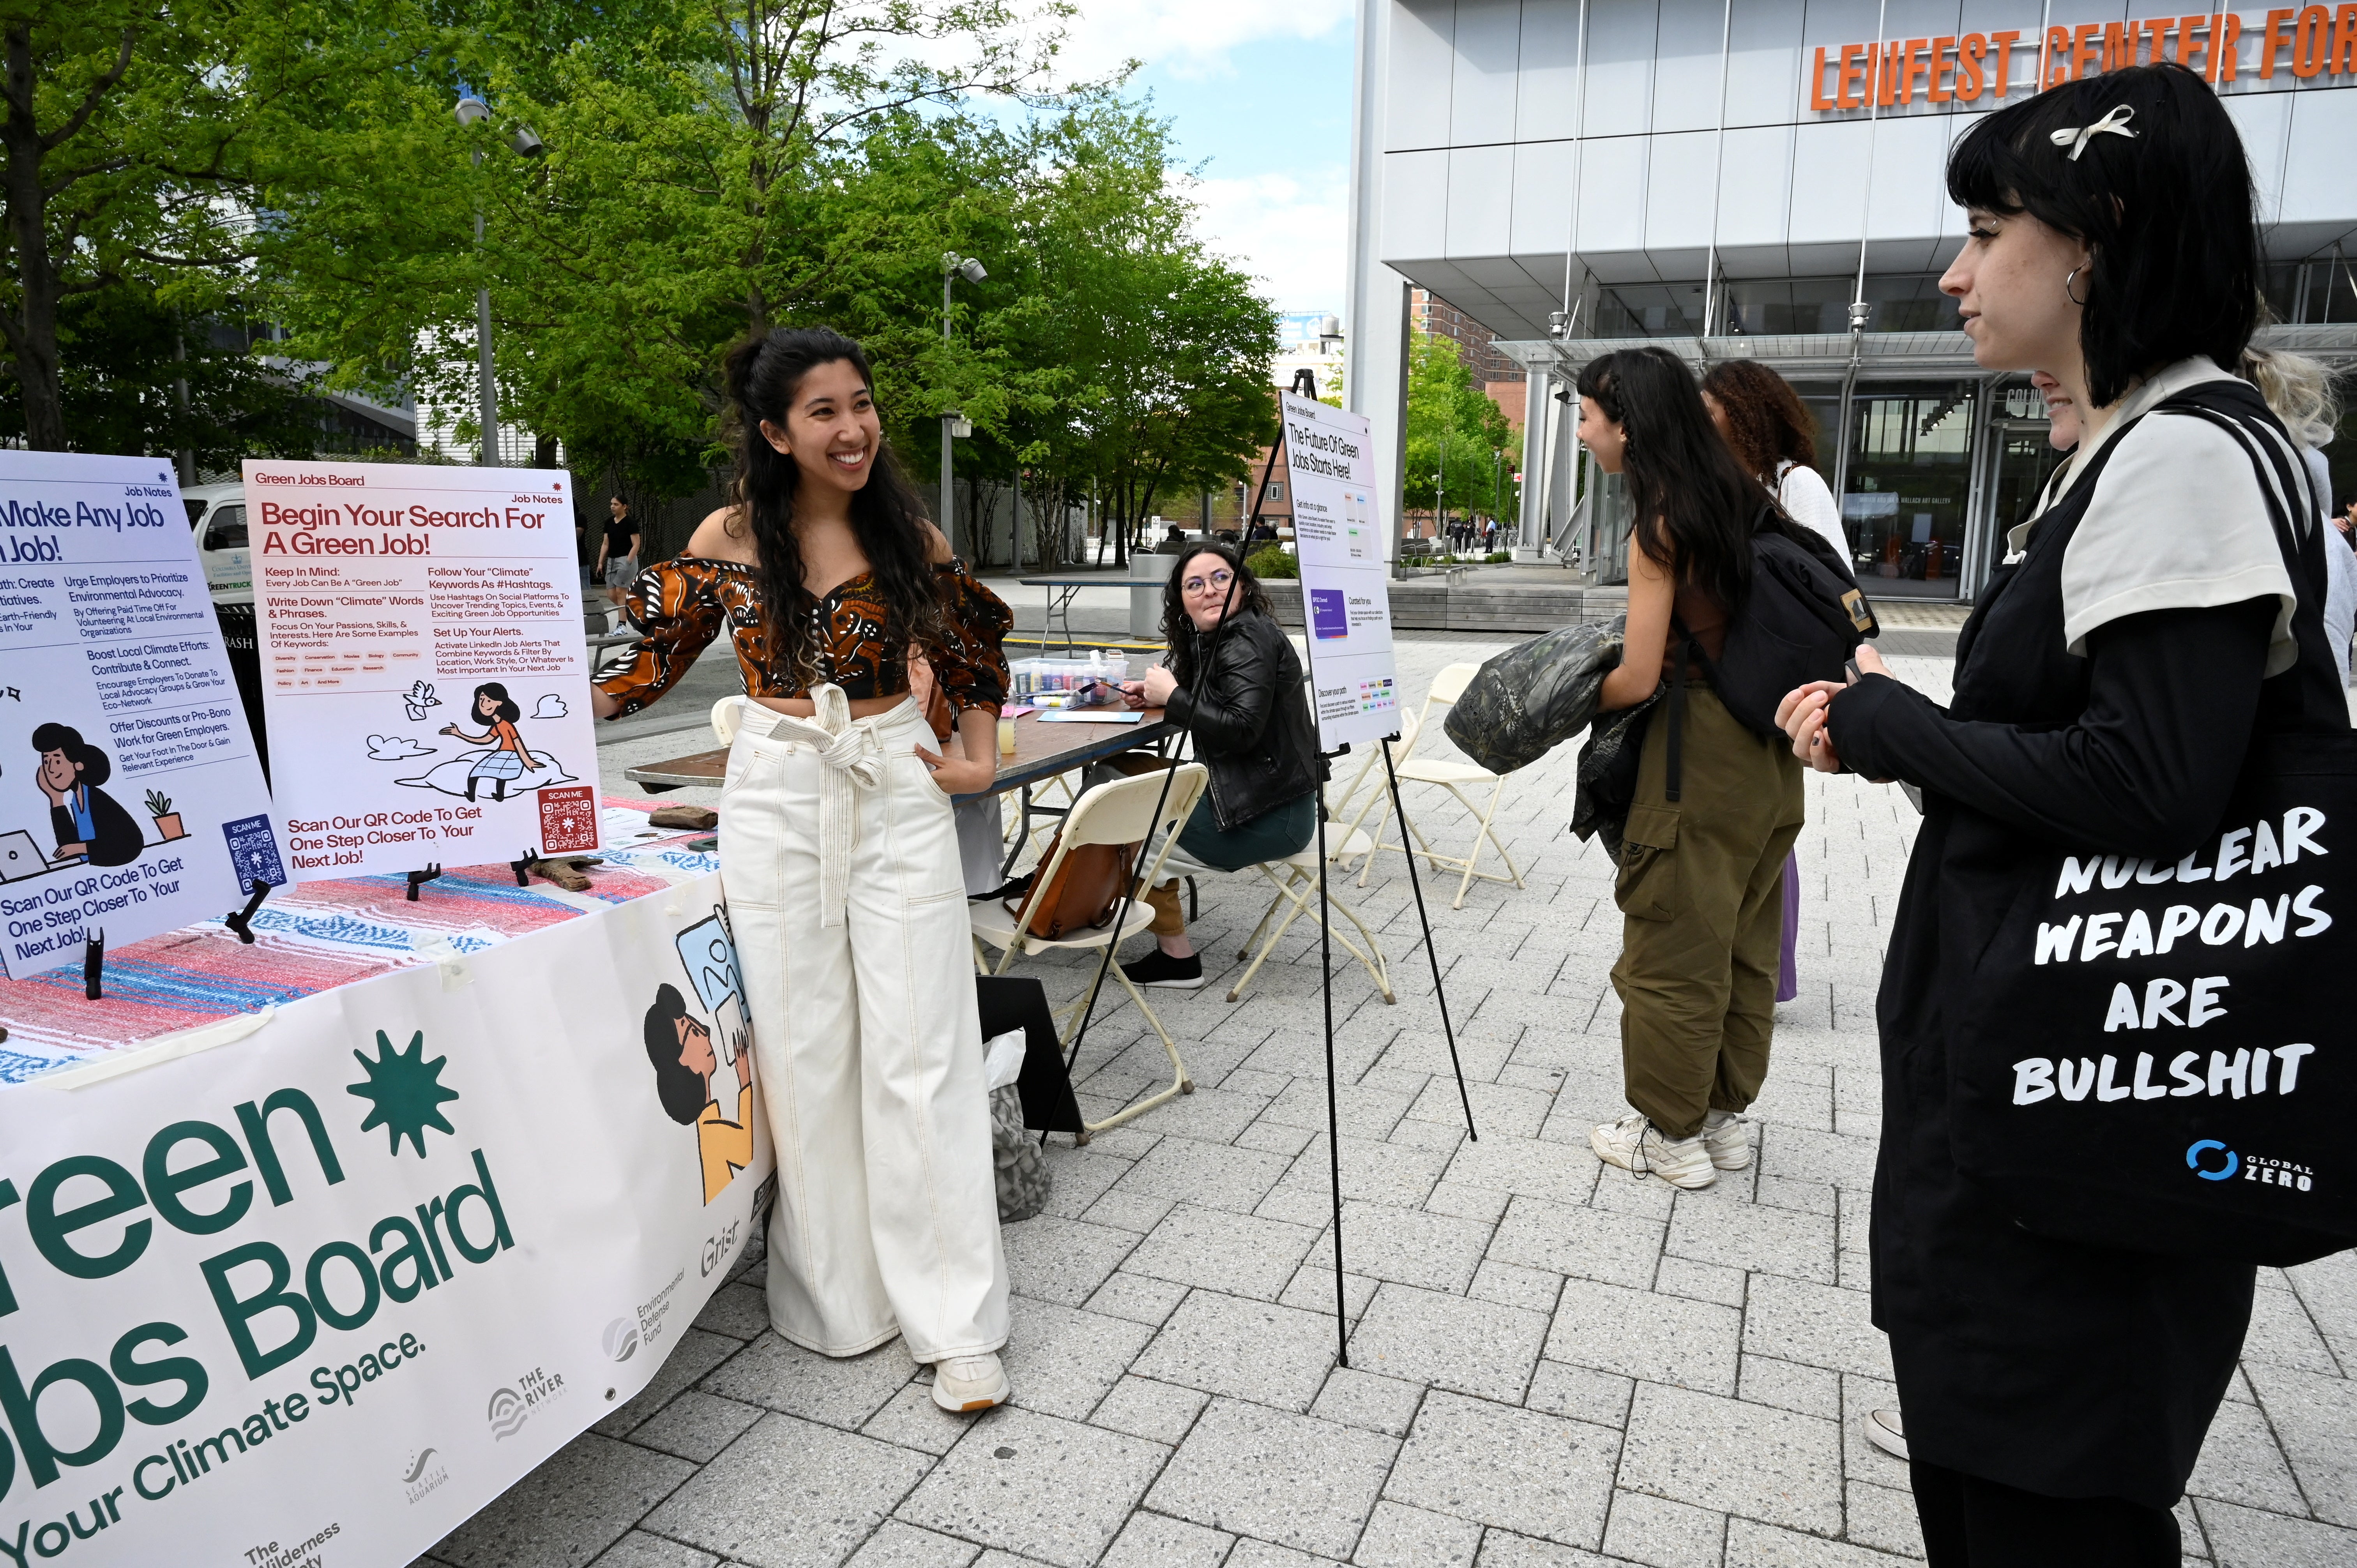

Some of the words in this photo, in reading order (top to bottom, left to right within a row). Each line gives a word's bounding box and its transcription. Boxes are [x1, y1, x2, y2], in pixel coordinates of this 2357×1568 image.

[1811, 31, 2020, 111] LENFEST
[2037, 13, 2241, 92] CENTER
[2260, 3, 2357, 79] FOR
[1286, 401, 1297, 414] Green
[1297, 405, 1306, 417] Jobs
[1305, 408, 1316, 420] Board
[1288, 422, 1304, 445] The
[1304, 427, 1328, 452] Future
[1329, 434, 1338, 454] Of
[1338, 437, 1359, 459] Green
[1292, 448, 1309, 471] Jobs
[1309, 452, 1332, 476] Starts
[1332, 458, 1351, 480] Here!
[125, 486, 143, 496] Job
[143, 486, 172, 497] Notes
[255, 472, 296, 484] Green
[298, 473, 327, 486] Jobs
[328, 474, 365, 486] Board
[511, 494, 531, 503] Job
[532, 494, 563, 504] Notes
[0, 500, 72, 527] Make
[76, 501, 121, 533] Any
[125, 502, 164, 527] Job
[261, 502, 341, 531] Begin
[343, 503, 405, 526] Your
[409, 505, 500, 528] Search
[505, 507, 545, 529] For
[10, 535, 63, 562] Job!
[263, 531, 288, 554] A
[291, 531, 375, 555] Green
[378, 533, 430, 555] Job!
[64, 576, 89, 589] Urge
[89, 575, 140, 588] Employers
[139, 575, 150, 584] to
[150, 572, 189, 583] Prioritize
[265, 567, 294, 578] Keep
[296, 567, 307, 576] In
[309, 567, 340, 576] Mind:
[431, 610, 463, 619] Exciting
[506, 609, 560, 618] Opportunities
[1348, 597, 1360, 605] Curated
[80, 626, 132, 639] Organizations
[433, 628, 452, 637] Set
[453, 628, 468, 639] Up
[468, 627, 491, 636] Your
[493, 627, 524, 636] Alerts.
[87, 649, 117, 660] Boost
[116, 645, 143, 658] Local
[143, 644, 179, 655] Climate
[178, 641, 210, 652] Efforts:
[102, 697, 152, 710] Eco-Network
[1318, 689, 1332, 697] Discover
[110, 721, 134, 733] Offer
[135, 715, 181, 729] Discounts
[182, 714, 191, 722] or
[191, 708, 231, 721] Pro-Bono
[548, 791, 571, 800] SCAN
[232, 822, 251, 834] SCAN
[250, 819, 262, 829] ME
[288, 819, 329, 833] Scan
[332, 816, 362, 830] Our
[364, 813, 389, 827] QR
[391, 810, 433, 825] Code
[433, 808, 452, 821] To
[455, 807, 482, 819] Get
[290, 837, 324, 851] One
[326, 834, 364, 849] Step
[367, 830, 417, 844] Closer
[417, 826, 436, 840] To
[440, 825, 474, 838] Your
[292, 854, 331, 869] Next
[332, 849, 363, 865] Job!
[2055, 807, 2329, 899] NUCLEAR
[0, 895, 44, 916] Scan
[44, 887, 72, 904] Our
[74, 878, 100, 897] QR
[100, 868, 140, 890] Code
[138, 863, 157, 879] To
[158, 857, 184, 874] Get
[8, 919, 43, 938] One
[43, 908, 81, 928] Step
[83, 894, 129, 916] Closer
[127, 887, 147, 904] To
[148, 880, 180, 897] Your
[2034, 885, 2332, 965] WEAPONS
[14, 936, 56, 961] Next
[56, 925, 87, 949] Job!
[2104, 976, 2230, 1032] ARE
[2012, 1043, 2315, 1105] BULLSHIT
[2246, 1155, 2313, 1175] GLOBAL
[2244, 1165, 2311, 1192] ZERO
[701, 1215, 739, 1278] Grist
[637, 1267, 684, 1319] Environmental
[0, 1323, 208, 1501] bs
[200, 1148, 515, 1381] Board
[640, 1301, 669, 1332] Defense
[643, 1321, 661, 1346] Fund
[518, 1367, 544, 1391] THE
[525, 1374, 564, 1407] RIVER
[531, 1387, 568, 1416] NETWORK
[0, 1485, 124, 1568] Your
[133, 1393, 309, 1501] Climate
[310, 1332, 426, 1407] Space.
[406, 1466, 446, 1497] SEATTLE
[409, 1473, 449, 1506] AQUARIUM
[244, 1541, 279, 1565] The
